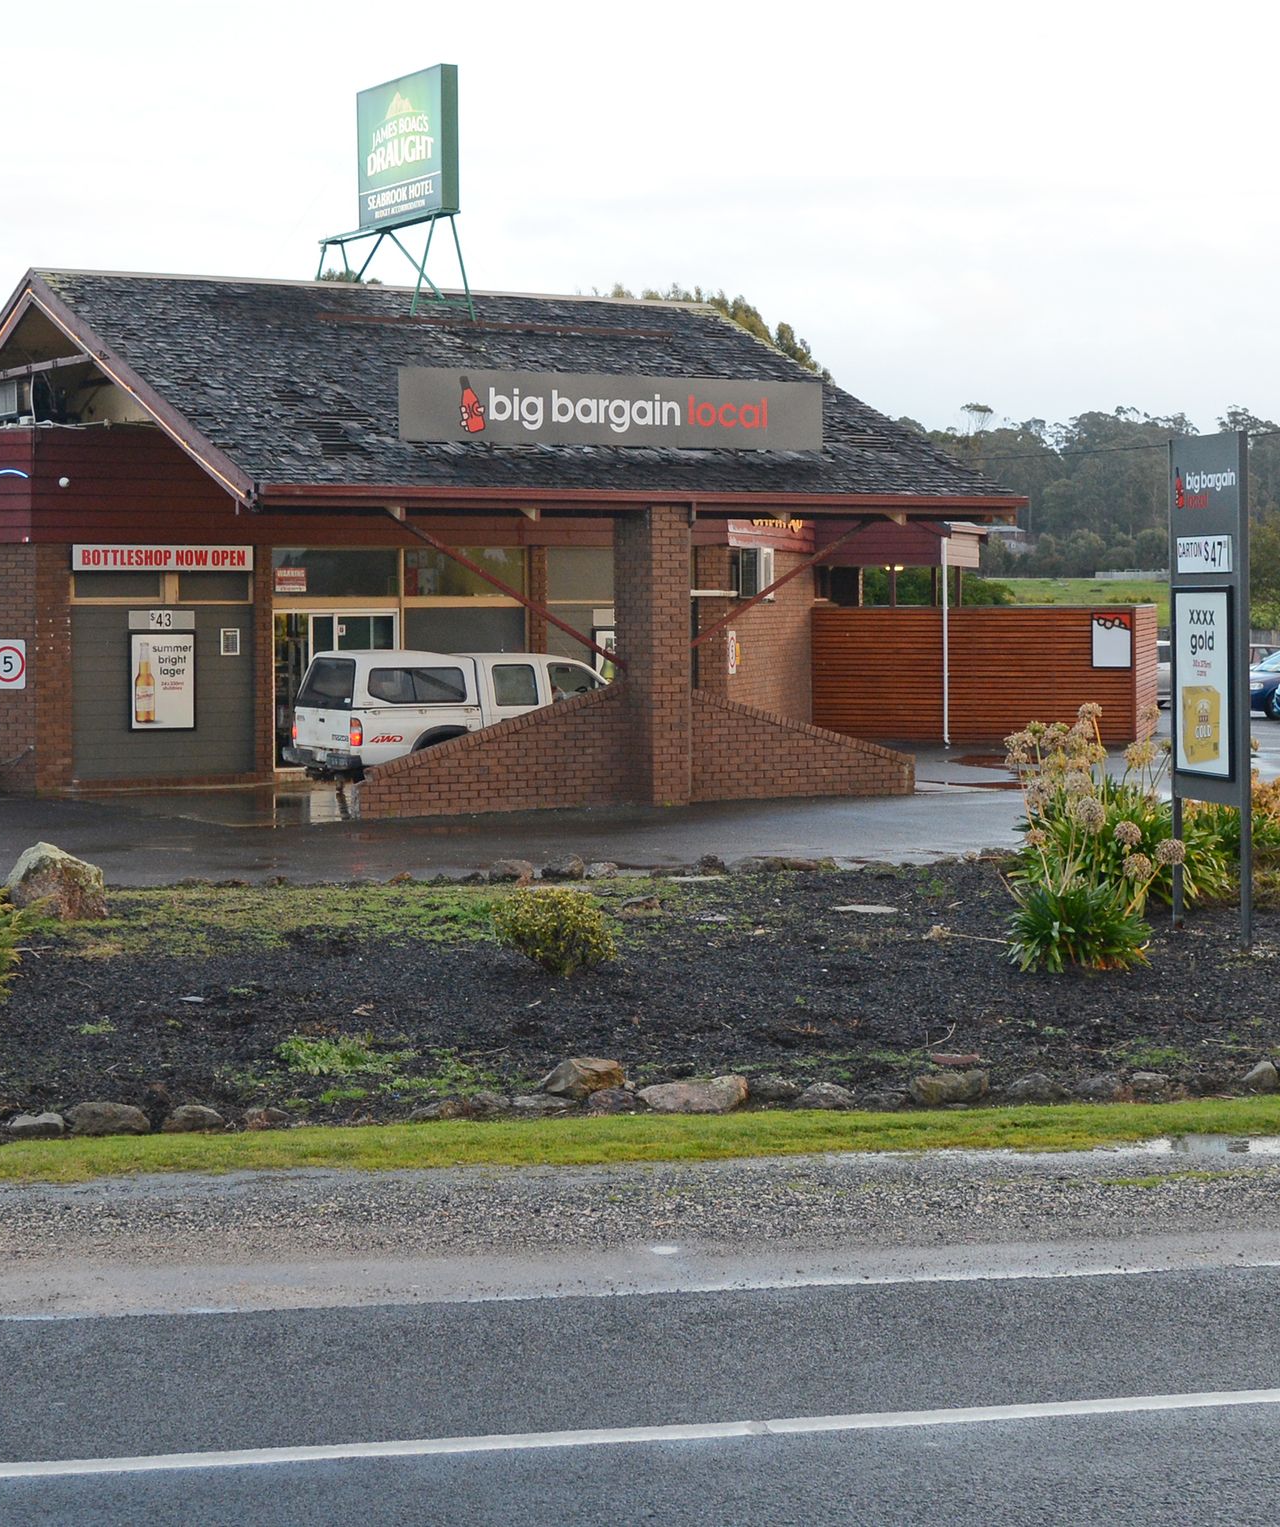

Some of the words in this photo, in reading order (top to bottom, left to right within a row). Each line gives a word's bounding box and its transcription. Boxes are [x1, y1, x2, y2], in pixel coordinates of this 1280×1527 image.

[372, 120, 398, 151] JAMES
[398, 113, 429, 134] BOAG'S
[367, 136, 434, 177] DRAUGHT
[368, 186, 408, 210] SEABROOK
[408, 179, 433, 198] HOTEL
[488, 387, 544, 431] big
[552, 389, 681, 433] bargain
[687, 394, 768, 430] local
[1185, 471, 1200, 494] big
[1201, 468, 1236, 491] bargain
[81, 549, 171, 566] BOTTLESHOP
[175, 550, 208, 566] NOW
[211, 550, 246, 566] OPEN
[1178, 541, 1202, 558] CARTON
[150, 612, 172, 627] $43
[152, 644, 192, 652] summer
[1190, 631, 1214, 655] gold
[3, 655, 13, 673] 5
[158, 655, 187, 666] bright
[160, 667, 185, 677] lager
[369, 735, 404, 743] 4WD
